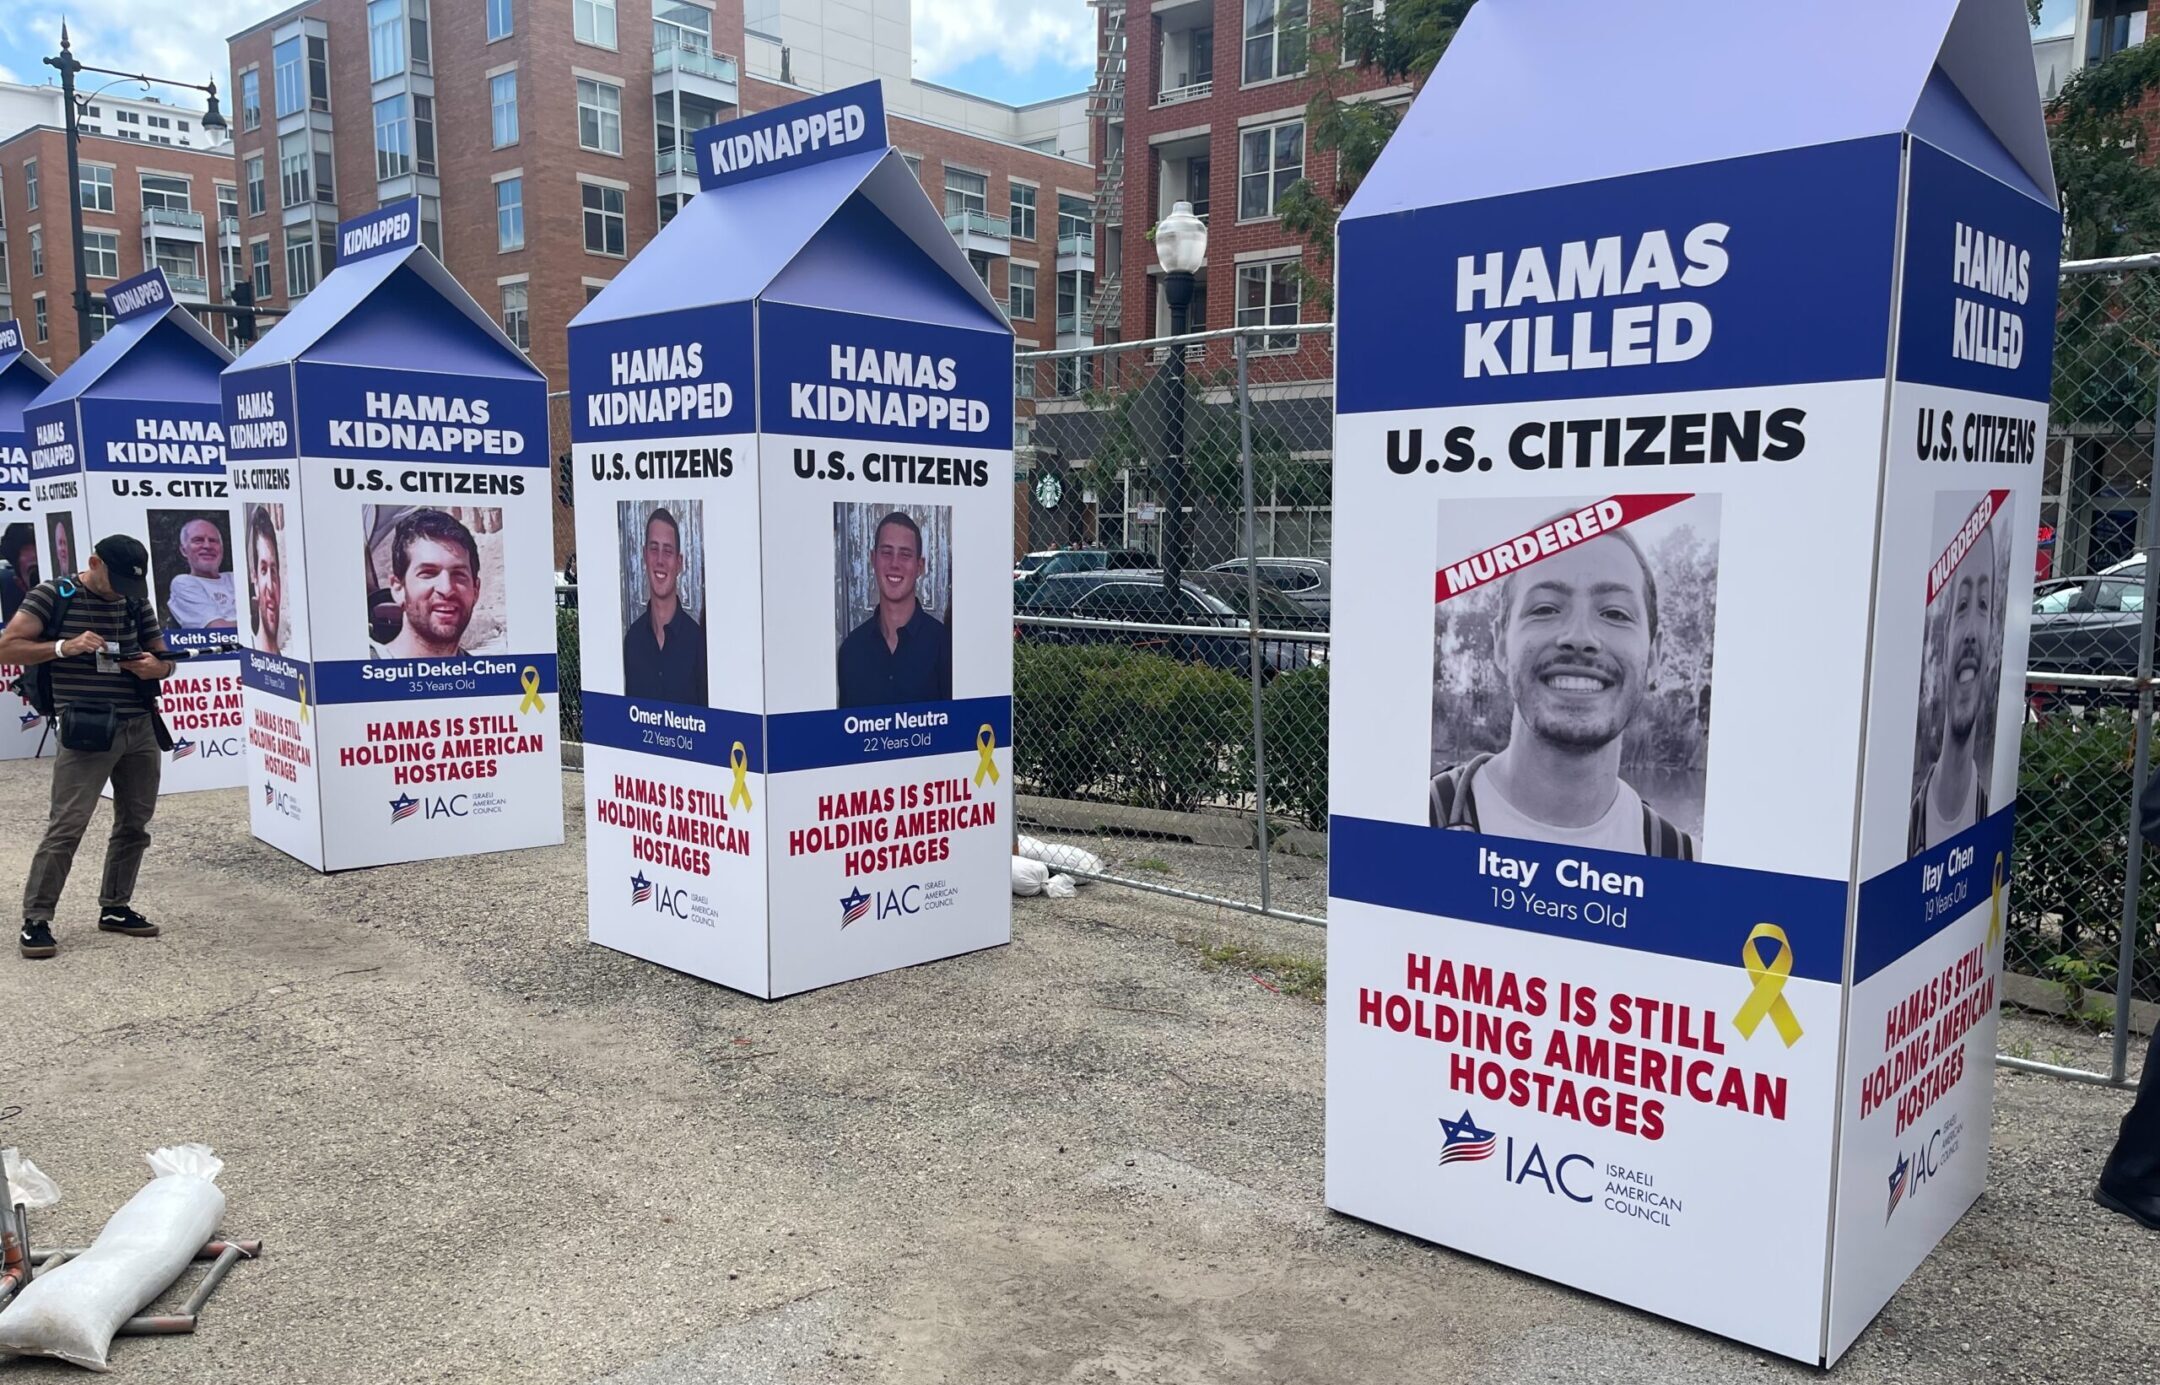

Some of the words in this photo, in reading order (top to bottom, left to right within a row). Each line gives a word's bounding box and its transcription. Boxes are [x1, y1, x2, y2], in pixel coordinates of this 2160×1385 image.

[710, 104, 864, 175] KIDNAPPED
[343, 212, 410, 256] KIDNAPPED
[1456, 223, 1731, 312] HAMAS
[1954, 221, 2030, 304] HAMAS
[112, 279, 164, 316] KIDNAPPED
[1463, 301, 1712, 379] KILLED
[1951, 299, 2023, 370] KILLED
[611, 342, 703, 386] HAMAS
[830, 344, 956, 391] HAMAS
[237, 391, 274, 420] HAMAS
[366, 392, 490, 425] HAMAS
[588, 382, 732, 427] KIDNAPPED
[791, 383, 990, 433] KIDNAPPED
[36, 421, 65, 447] HAMAS
[136, 419, 225, 442] HAMA
[230, 421, 287, 450] KIDNAPPED
[329, 420, 524, 455] KIDNAPPED
[1386, 429, 1493, 475] U.S.
[1508, 408, 1807, 469] CITIZENS
[1917, 408, 1957, 462] U.S.
[1963, 408, 2035, 465] CITIZENS
[31, 444, 75, 470] KIDNAPPED
[107, 442, 227, 466] KIDNAP
[592, 453, 630, 480] U.S.
[635, 447, 733, 479] CITIZENS
[794, 449, 854, 481] U.S.
[862, 452, 988, 487] CITIZENS
[36, 486, 48, 502] U.S.
[50, 481, 78, 500] CITIZENS
[112, 479, 162, 497] U.S.
[167, 480, 228, 498] CITIZ
[233, 469, 250, 490] U.S.
[251, 469, 290, 490] CITIZENS
[334, 468, 393, 491] U.S.
[400, 471, 524, 496] CITIZENS
[1444, 500, 1624, 596] MURDERED
[1931, 495, 1993, 590] MURDERED
[170, 634, 206, 644] Keith
[209, 632, 238, 644] Sieg
[162, 678, 212, 695] AMAS
[216, 677, 232, 691] IS
[362, 664, 414, 682] Sagui
[417, 660, 516, 677] Dekel-Chen
[409, 682, 423, 692] 35
[426, 680, 453, 692] Years
[456, 680, 475, 690] Old
[159, 696, 208, 713] DING
[173, 712, 242, 730] HOSTAG
[629, 705, 662, 726] Omer
[665, 710, 706, 733] Neutra
[255, 709, 277, 732] HAMAS
[277, 716, 283, 734] IS
[285, 718, 302, 741] STILL
[367, 720, 440, 742] HAMAS
[446, 718, 464, 736] IS
[469, 715, 518, 735] STILL
[844, 715, 892, 734] Omer
[895, 711, 948, 729] Neutra
[200, 738, 238, 759] IAC
[249, 728, 275, 753] HOLDING
[277, 734, 310, 768] AMERICAN
[340, 741, 435, 766] HOLDING
[442, 735, 543, 758] AMERICAN
[642, 729, 654, 744] 22
[656, 731, 676, 748] Years
[678, 733, 693, 750] Old
[864, 738, 878, 751] 22
[879, 735, 908, 750] Years
[910, 733, 931, 746] Old
[264, 755, 296, 783] HOSTAGES
[394, 760, 497, 785] HOSTAGES
[275, 789, 289, 816] IAC
[425, 794, 468, 819] IAC
[473, 798, 506, 807] AMERICAN
[473, 806, 502, 815] COUNCIL
[614, 774, 666, 807] HAMAS
[670, 786, 684, 810] IS
[688, 789, 728, 820] STILL
[819, 787, 894, 821] HAMAS
[900, 784, 919, 808] IS
[923, 778, 972, 805] STILL
[598, 799, 662, 836] HOLDING
[667, 816, 750, 856] AMERICAN
[789, 818, 887, 856] HOLDING
[894, 802, 996, 838] AMERICAN
[633, 835, 710, 877] HOSTAGES
[845, 837, 949, 877] HOSTAGES
[1922, 862, 1944, 893] Itay
[1948, 845, 1974, 877] Chen
[924, 880, 946, 890] ISRAELI
[1478, 848, 1539, 888] Itay
[1555, 859, 1644, 898] Chen
[655, 883, 688, 920] IAC
[877, 885, 920, 920] IAC
[924, 886, 958, 900] AMERICAN
[924, 898, 954, 911] COUNCIL
[1491, 886, 1515, 910] 19
[1521, 894, 1577, 920] Years
[1584, 901, 1627, 928] Old
[1925, 898, 1934, 922] 19
[1935, 891, 1953, 917] Years
[1954, 877, 1968, 904] Old
[691, 903, 719, 918] AMERICAN
[691, 914, 715, 928] COUNCIL
[1407, 953, 1547, 1017] HAMAS
[1560, 982, 1597, 1027] IS
[1609, 993, 1725, 1055] STILL
[1885, 977, 1938, 1052] HAMAS
[1940, 966, 1952, 1011] IS
[1954, 943, 1984, 998] STILL
[1359, 988, 1532, 1060] HOLDING
[1544, 1030, 1787, 1120] AMERICAN
[1860, 1040, 1929, 1120] HOLDING
[1931, 975, 1995, 1063] AMERICAN
[1450, 1053, 1665, 1141] HOSTAGES
[1895, 1043, 1965, 1138] HOSTAGES
[1506, 1136, 1594, 1203] IAC
[1606, 1164, 1654, 1187] ISRAELI
[1909, 1129, 1940, 1199] IAC
[1604, 1198, 1671, 1227] COUNCIL
[1605, 1182, 1682, 1213] AMERICAN
